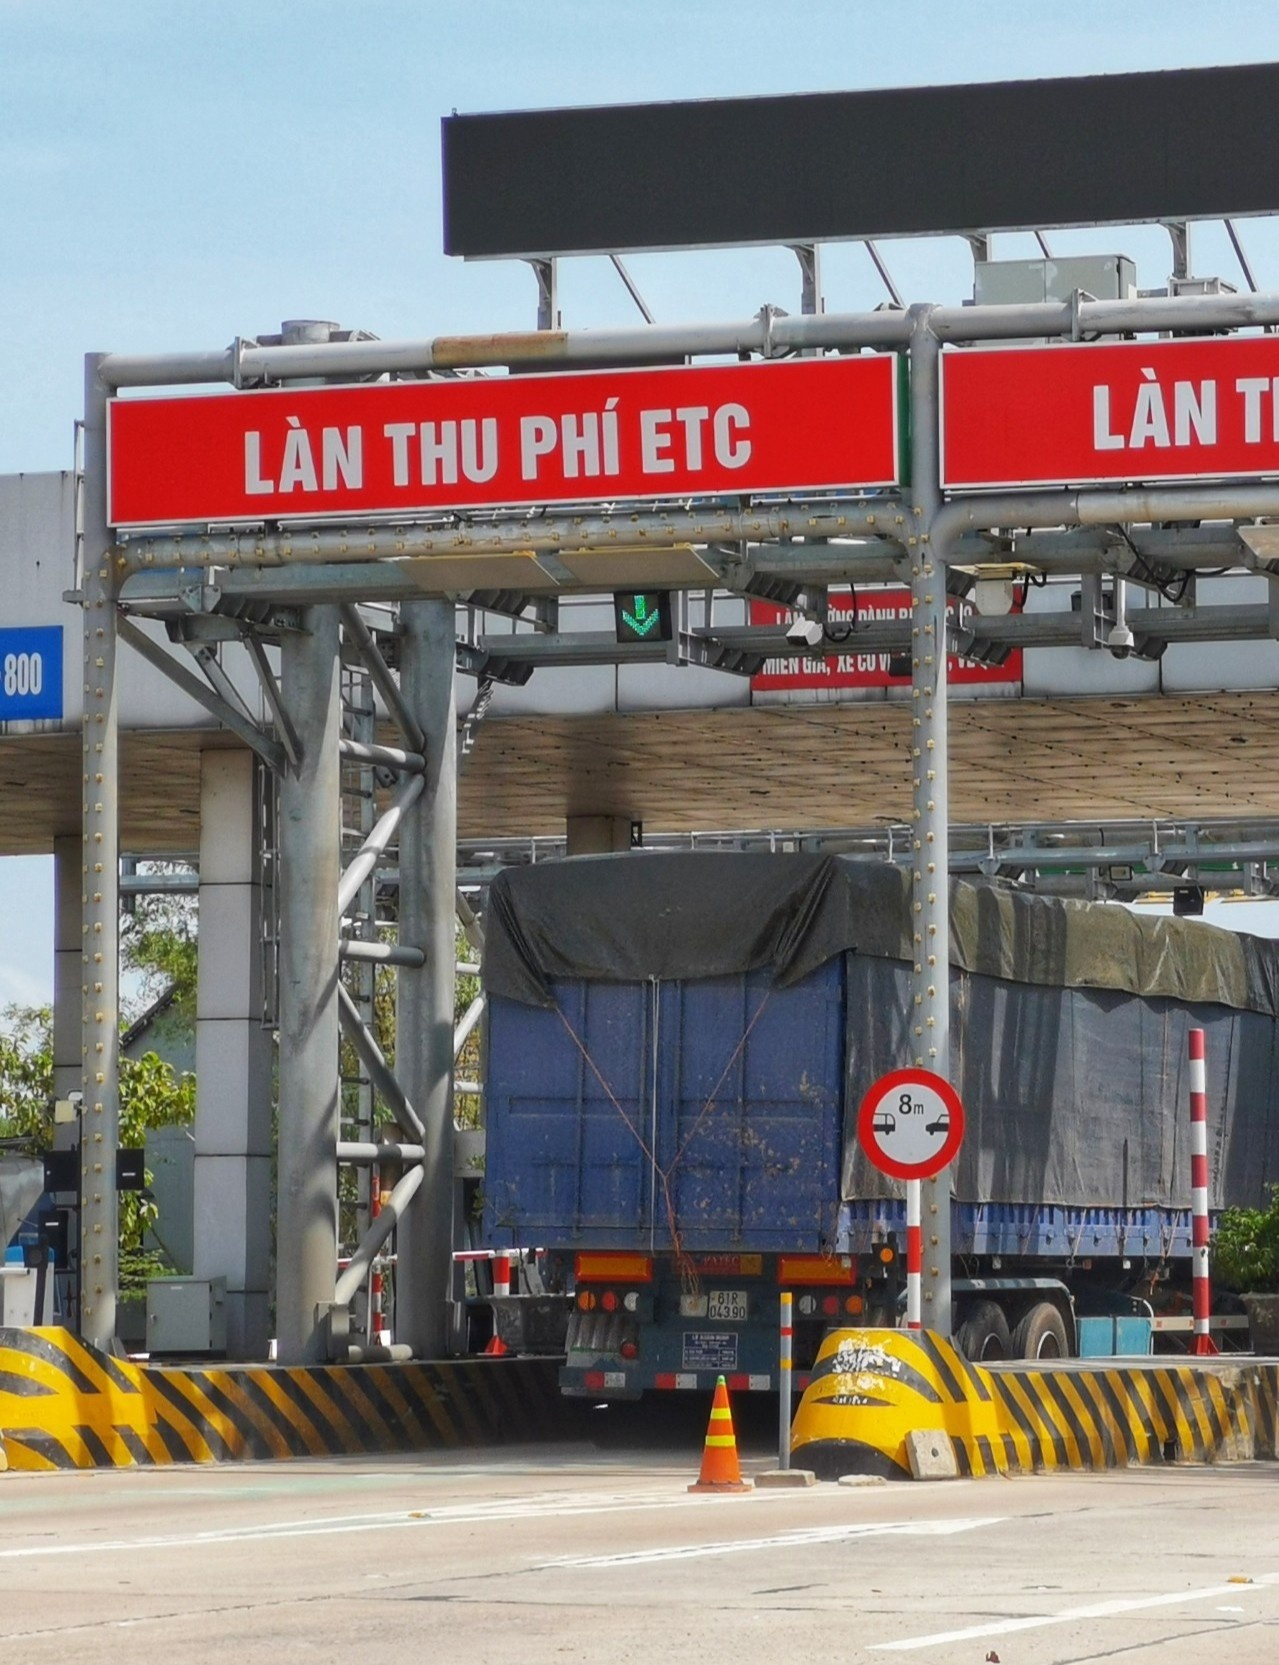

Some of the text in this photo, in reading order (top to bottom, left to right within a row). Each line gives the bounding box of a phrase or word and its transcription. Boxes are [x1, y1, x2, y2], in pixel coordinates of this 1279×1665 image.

[245, 398, 751, 494] LÀN THU PHÍ ETC
[1094, 368, 1216, 450] LÀN
[4, 652, 42, 696] 800
